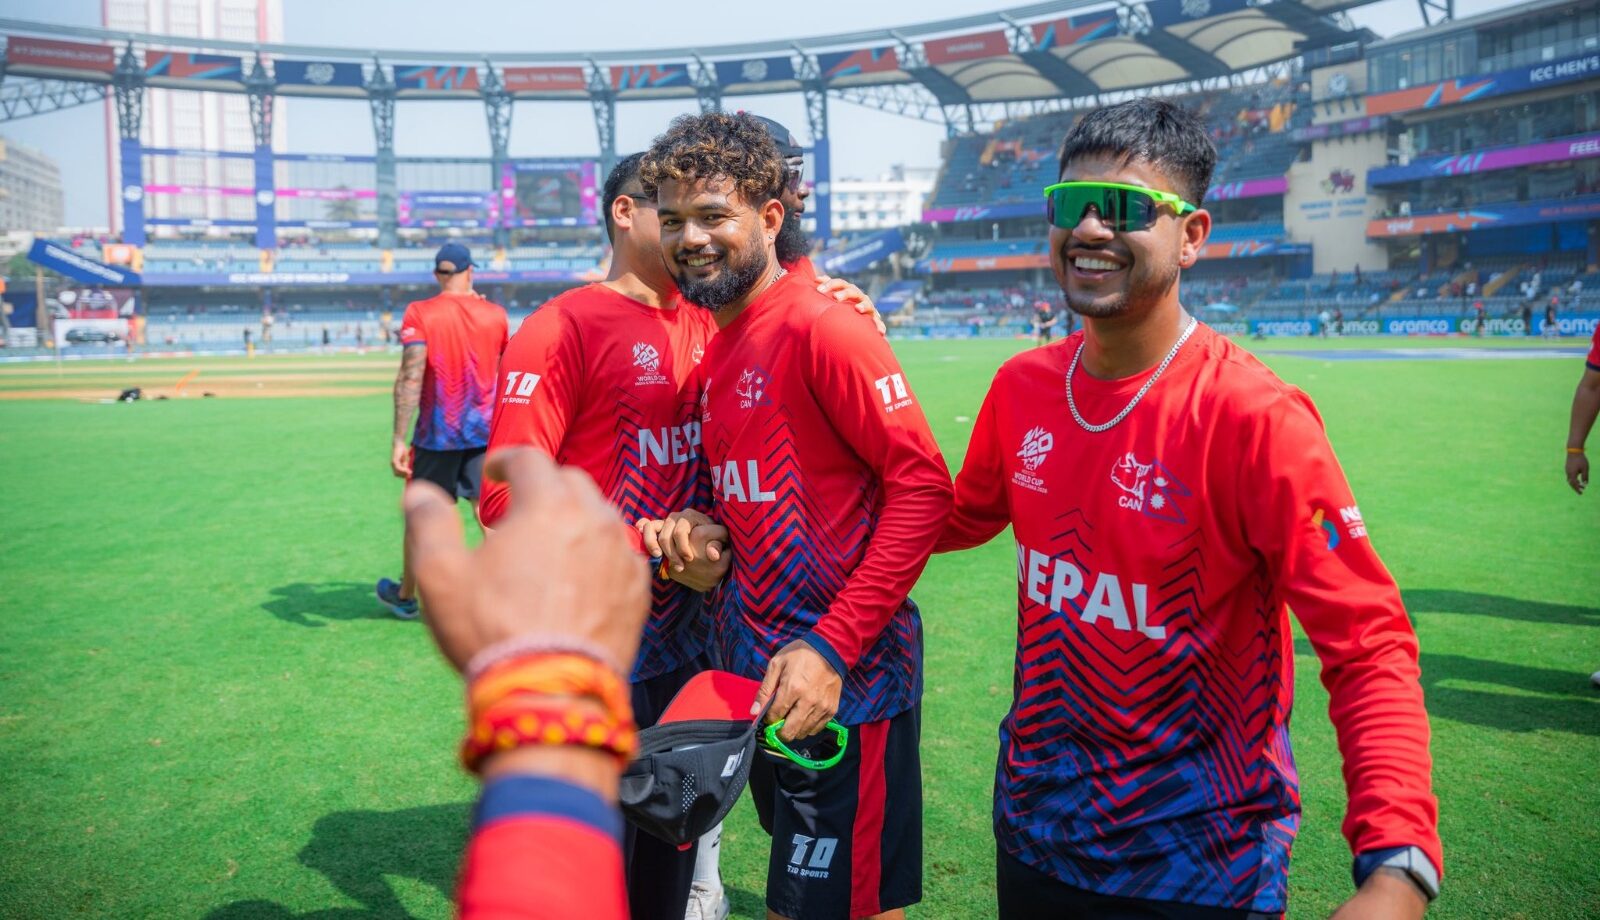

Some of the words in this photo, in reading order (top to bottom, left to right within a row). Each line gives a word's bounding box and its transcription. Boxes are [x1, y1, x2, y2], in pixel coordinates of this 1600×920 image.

[1530, 65, 1554, 83] ICC
[1555, 55, 1600, 78] MEN'S
[1568, 140, 1600, 155] FEEL
[1389, 319, 1449, 333] aramco
[1539, 317, 1600, 334] aamc
[740, 399, 752, 409] CAN
[1014, 472, 1031, 483] WORLD
[1031, 477, 1044, 486] CUP
[1118, 496, 1143, 512] CAN
[1016, 539, 1166, 640] NEPAL
[800, 868, 829, 879] SPORTS
